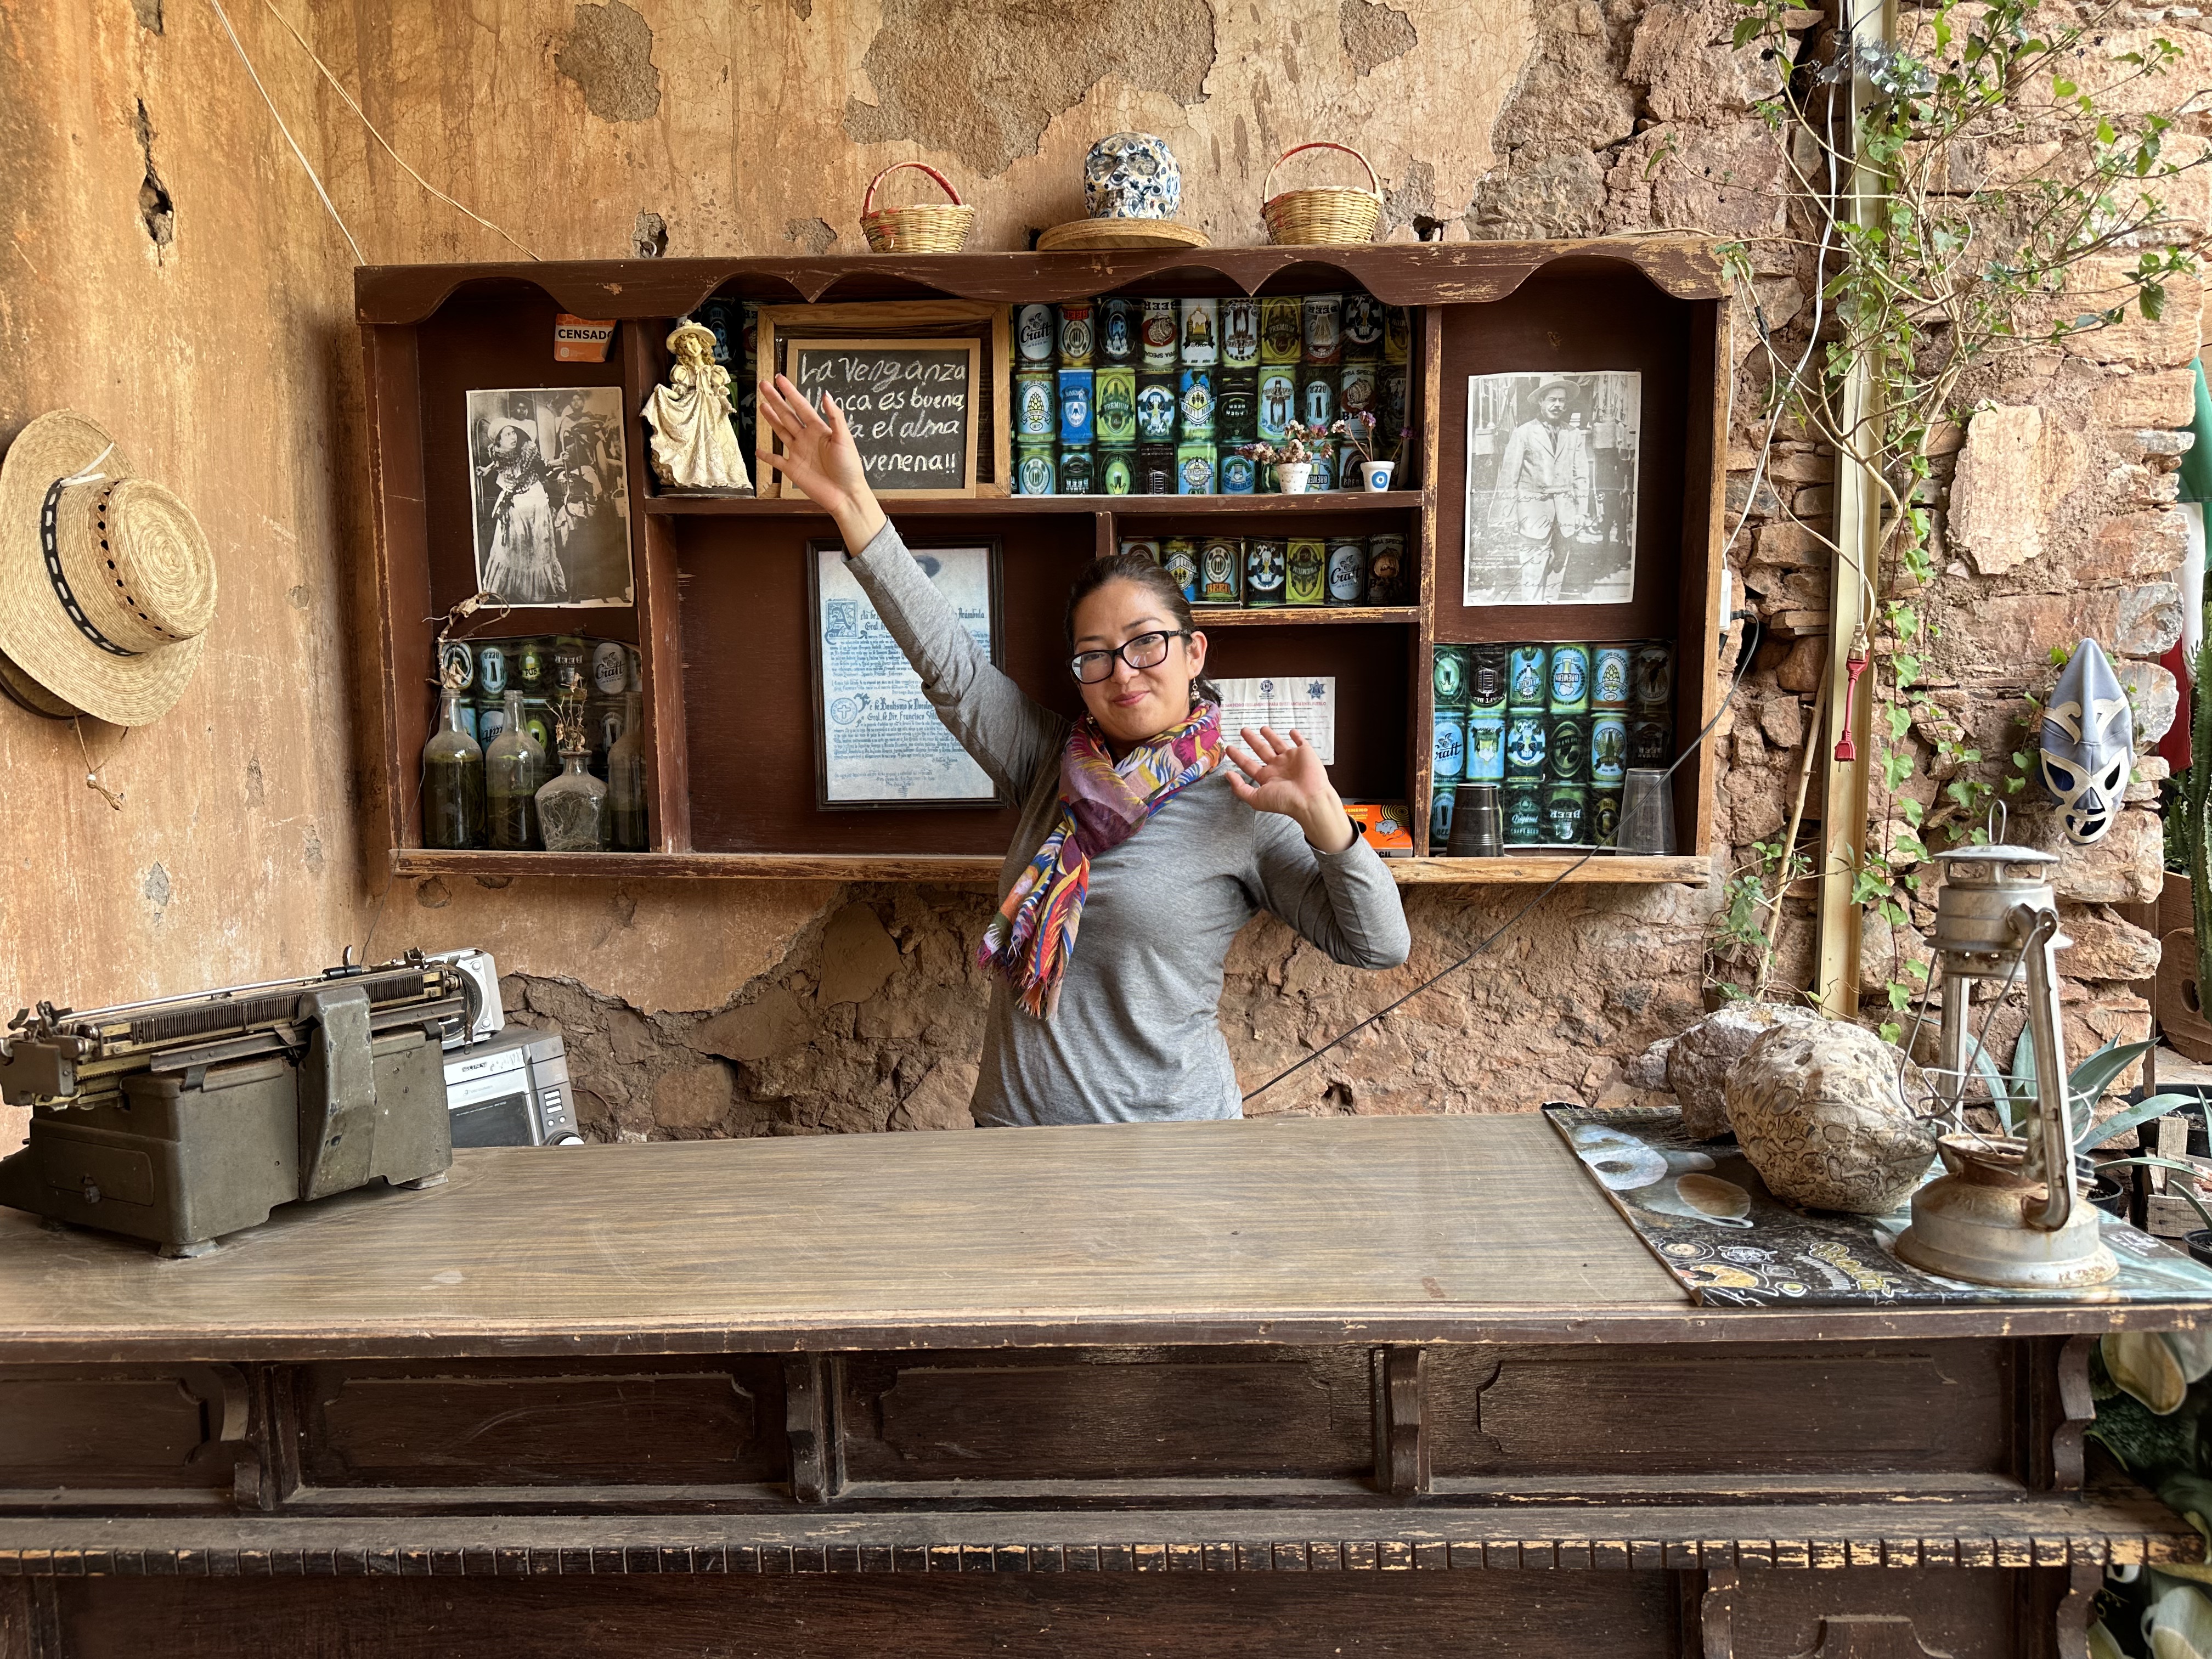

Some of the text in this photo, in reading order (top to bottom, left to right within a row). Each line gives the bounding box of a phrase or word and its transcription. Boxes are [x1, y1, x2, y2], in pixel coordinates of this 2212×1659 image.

[1308, 305, 1338, 314] BEER
[1020, 321, 1052, 343] Craft
[801, 353, 966, 392] La Venganza
[879, 391, 905, 411] es
[1104, 401, 1129, 410] PREMIUM
[1344, 412, 1359, 421] BE
[872, 411, 899, 439] el
[900, 410, 960, 439] alma
[860, 453, 956, 473] venena!!
[1308, 475, 1328, 483] BREWER
[1293, 566, 1317, 575] PREMIUM
[1331, 564, 1364, 585] Craft
[1206, 583, 1231, 594] BEER
[554, 654, 583, 664] BEER
[525, 667, 538, 676] PUB
[596, 660, 626, 680] Craft
[1556, 674, 1579, 682] BREWERY
[900, 712, 925, 722] Francisco
[1550, 809, 1581, 819] BEER
[462, 1062, 487, 1072] SONY
